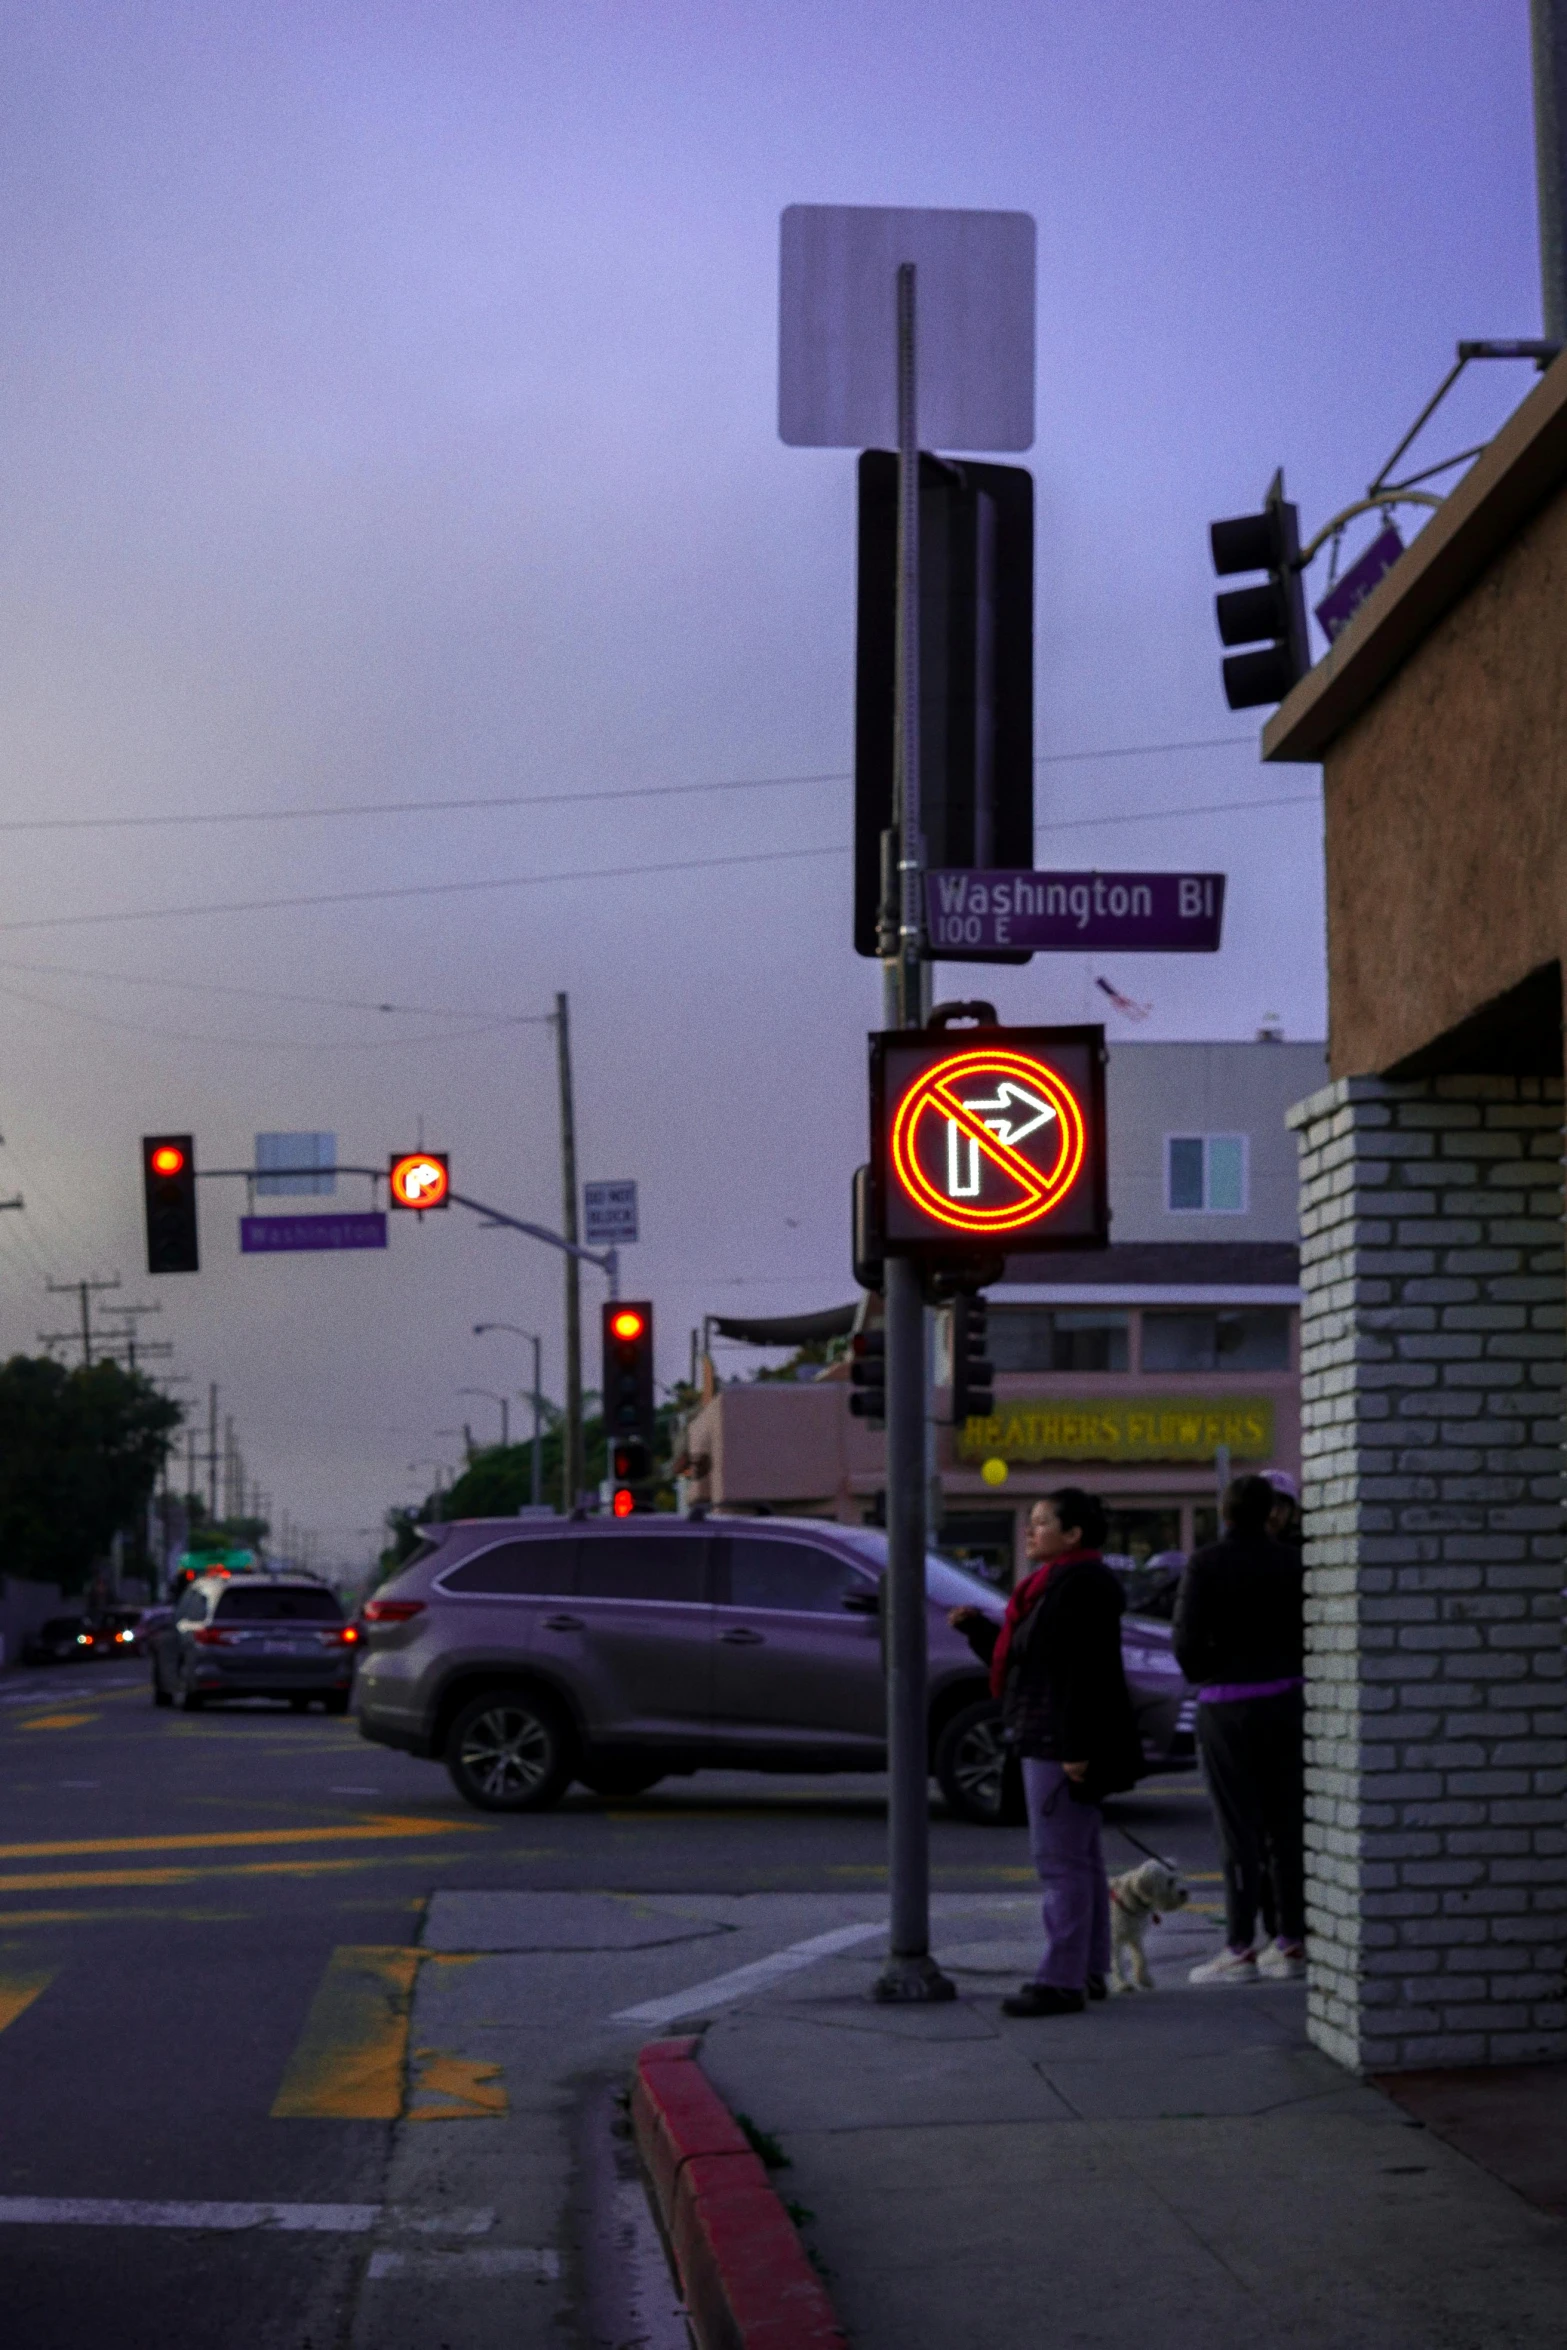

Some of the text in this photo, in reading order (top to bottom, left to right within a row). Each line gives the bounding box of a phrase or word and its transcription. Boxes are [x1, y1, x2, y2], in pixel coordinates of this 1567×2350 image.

[937, 875, 1214, 929] Washington Bl
[938, 915, 1011, 944] 100 E
[250, 1223, 380, 1246] Washington
[1128, 1412, 1264, 1445] FLOWERS
